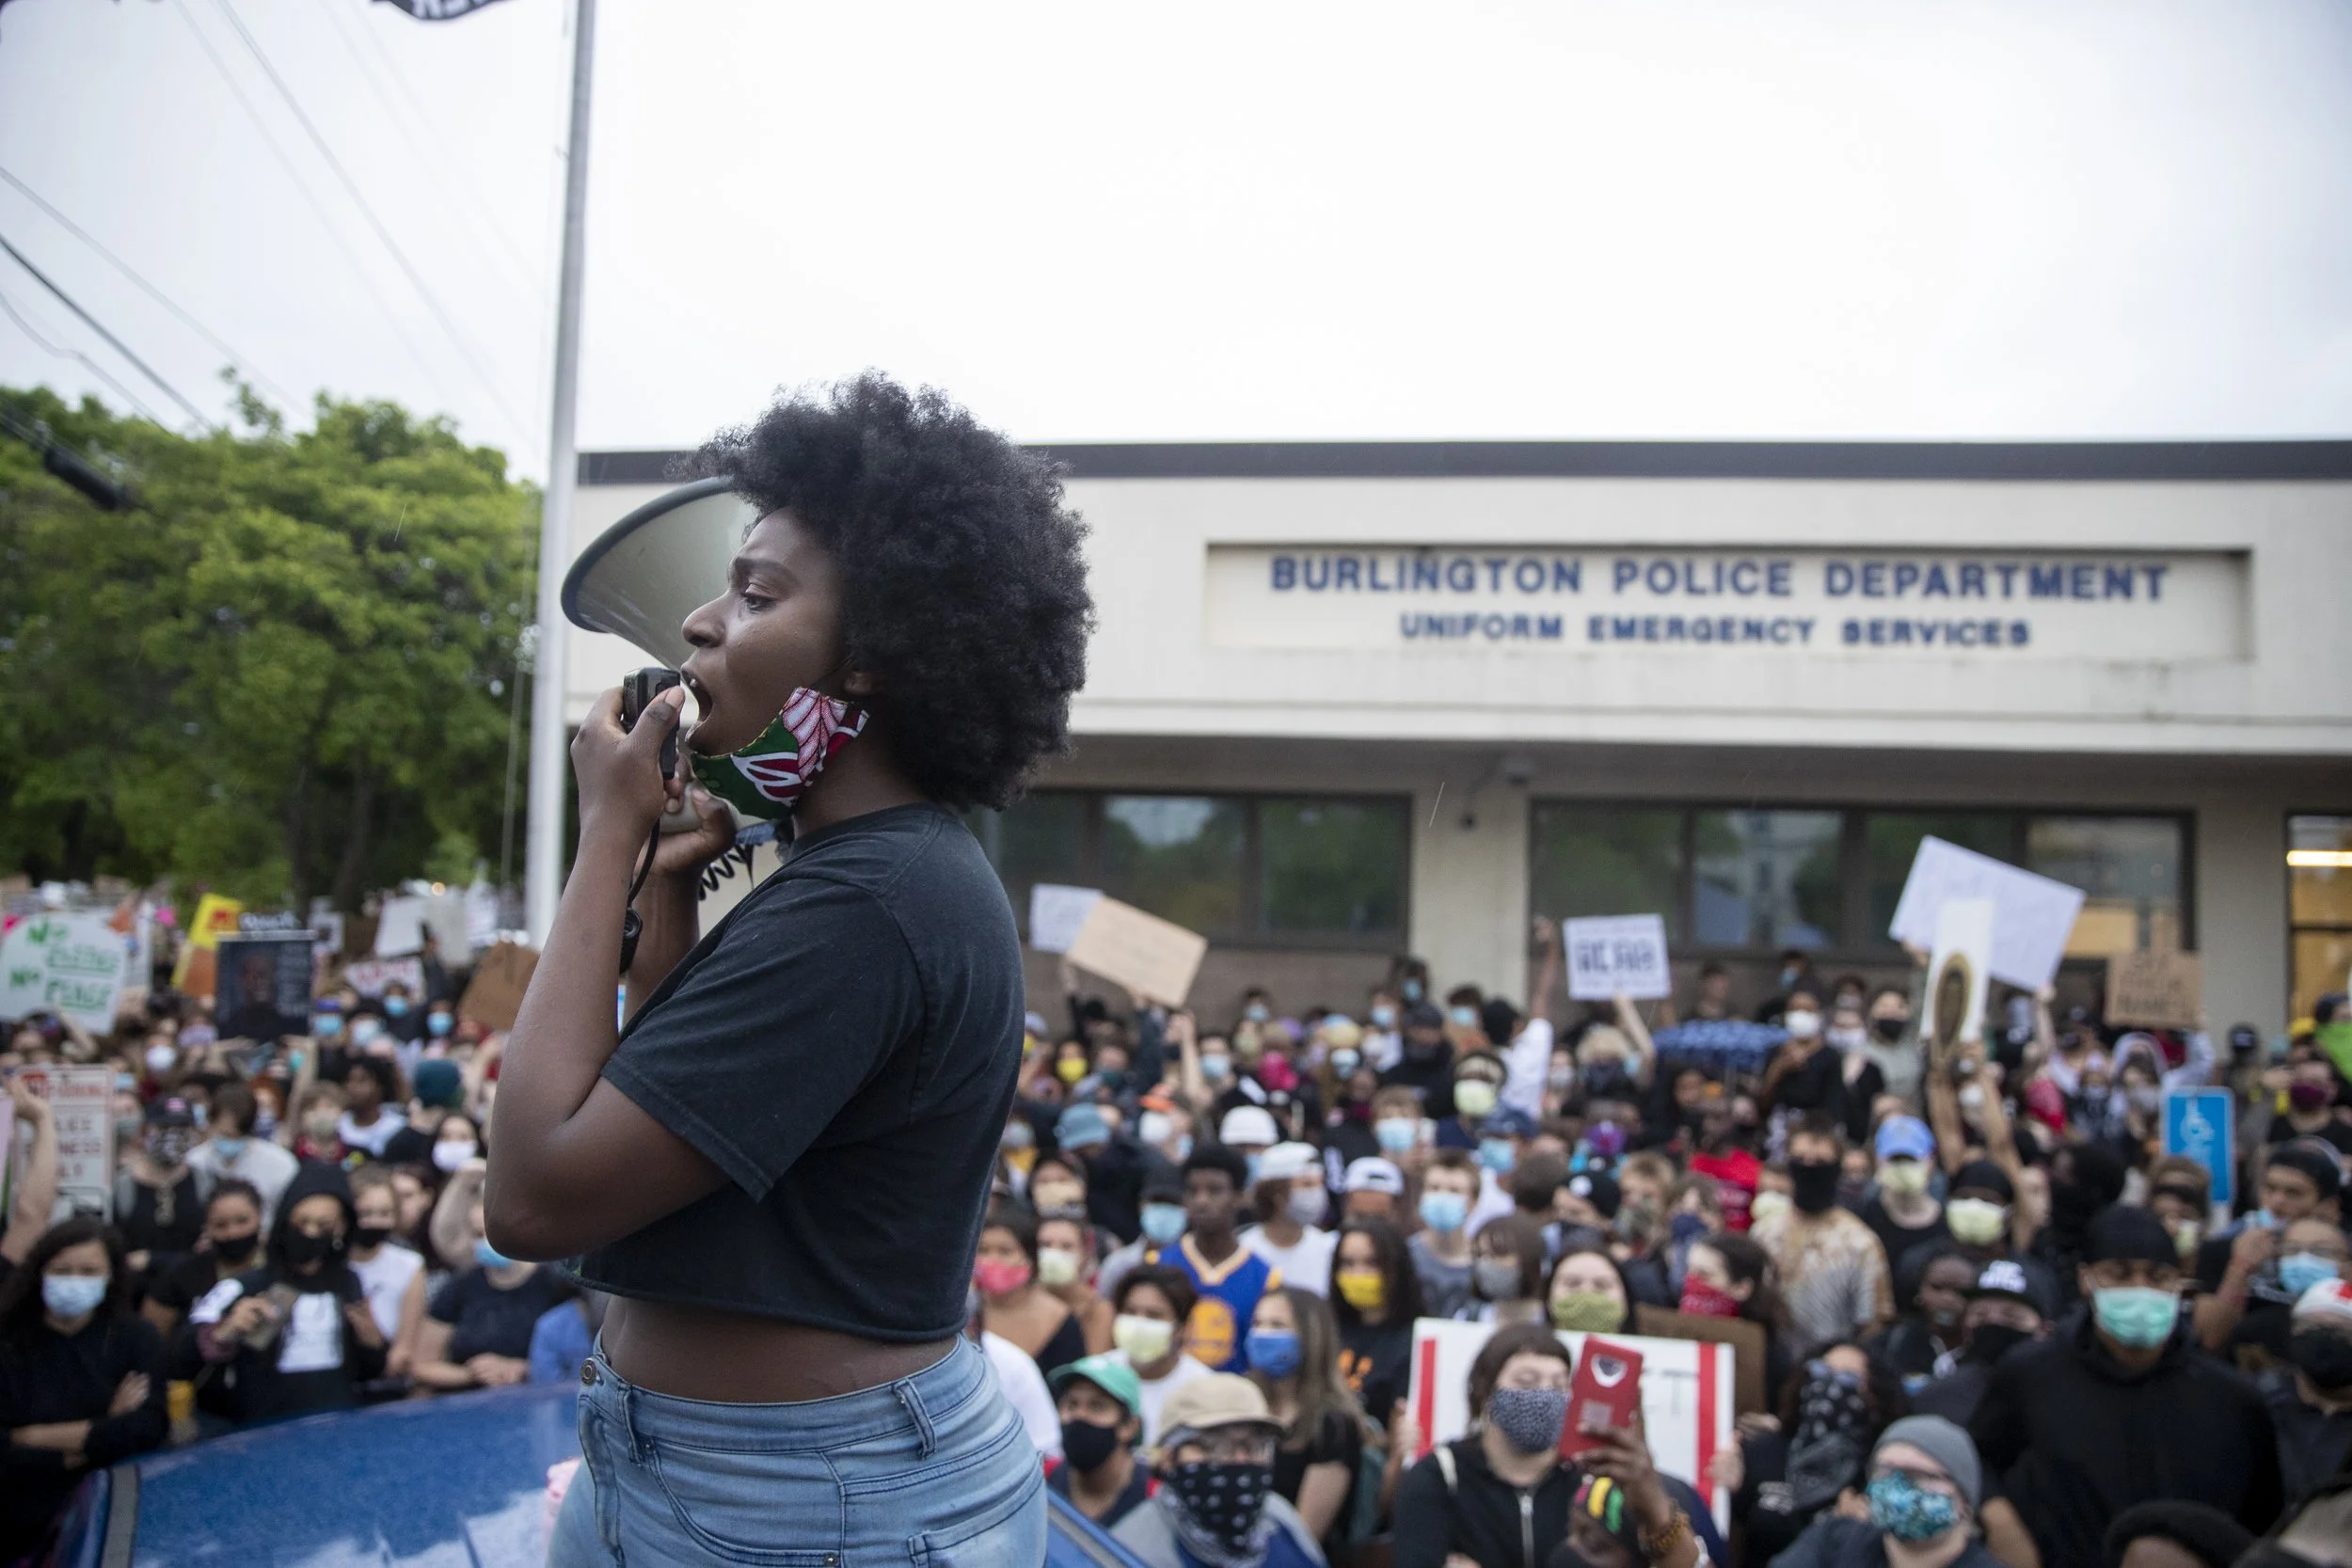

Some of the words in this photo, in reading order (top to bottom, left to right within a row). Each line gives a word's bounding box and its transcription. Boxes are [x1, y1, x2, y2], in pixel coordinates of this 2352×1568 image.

[1270, 555, 1582, 594] BURLINGTON
[1612, 559, 1794, 597] POLICE
[1823, 561, 2170, 602] DEPARTMENT
[1400, 612, 1565, 641] UNIFORM
[1586, 614, 1816, 645] EMERGENCY
[1840, 617, 2032, 647] SERVICES
